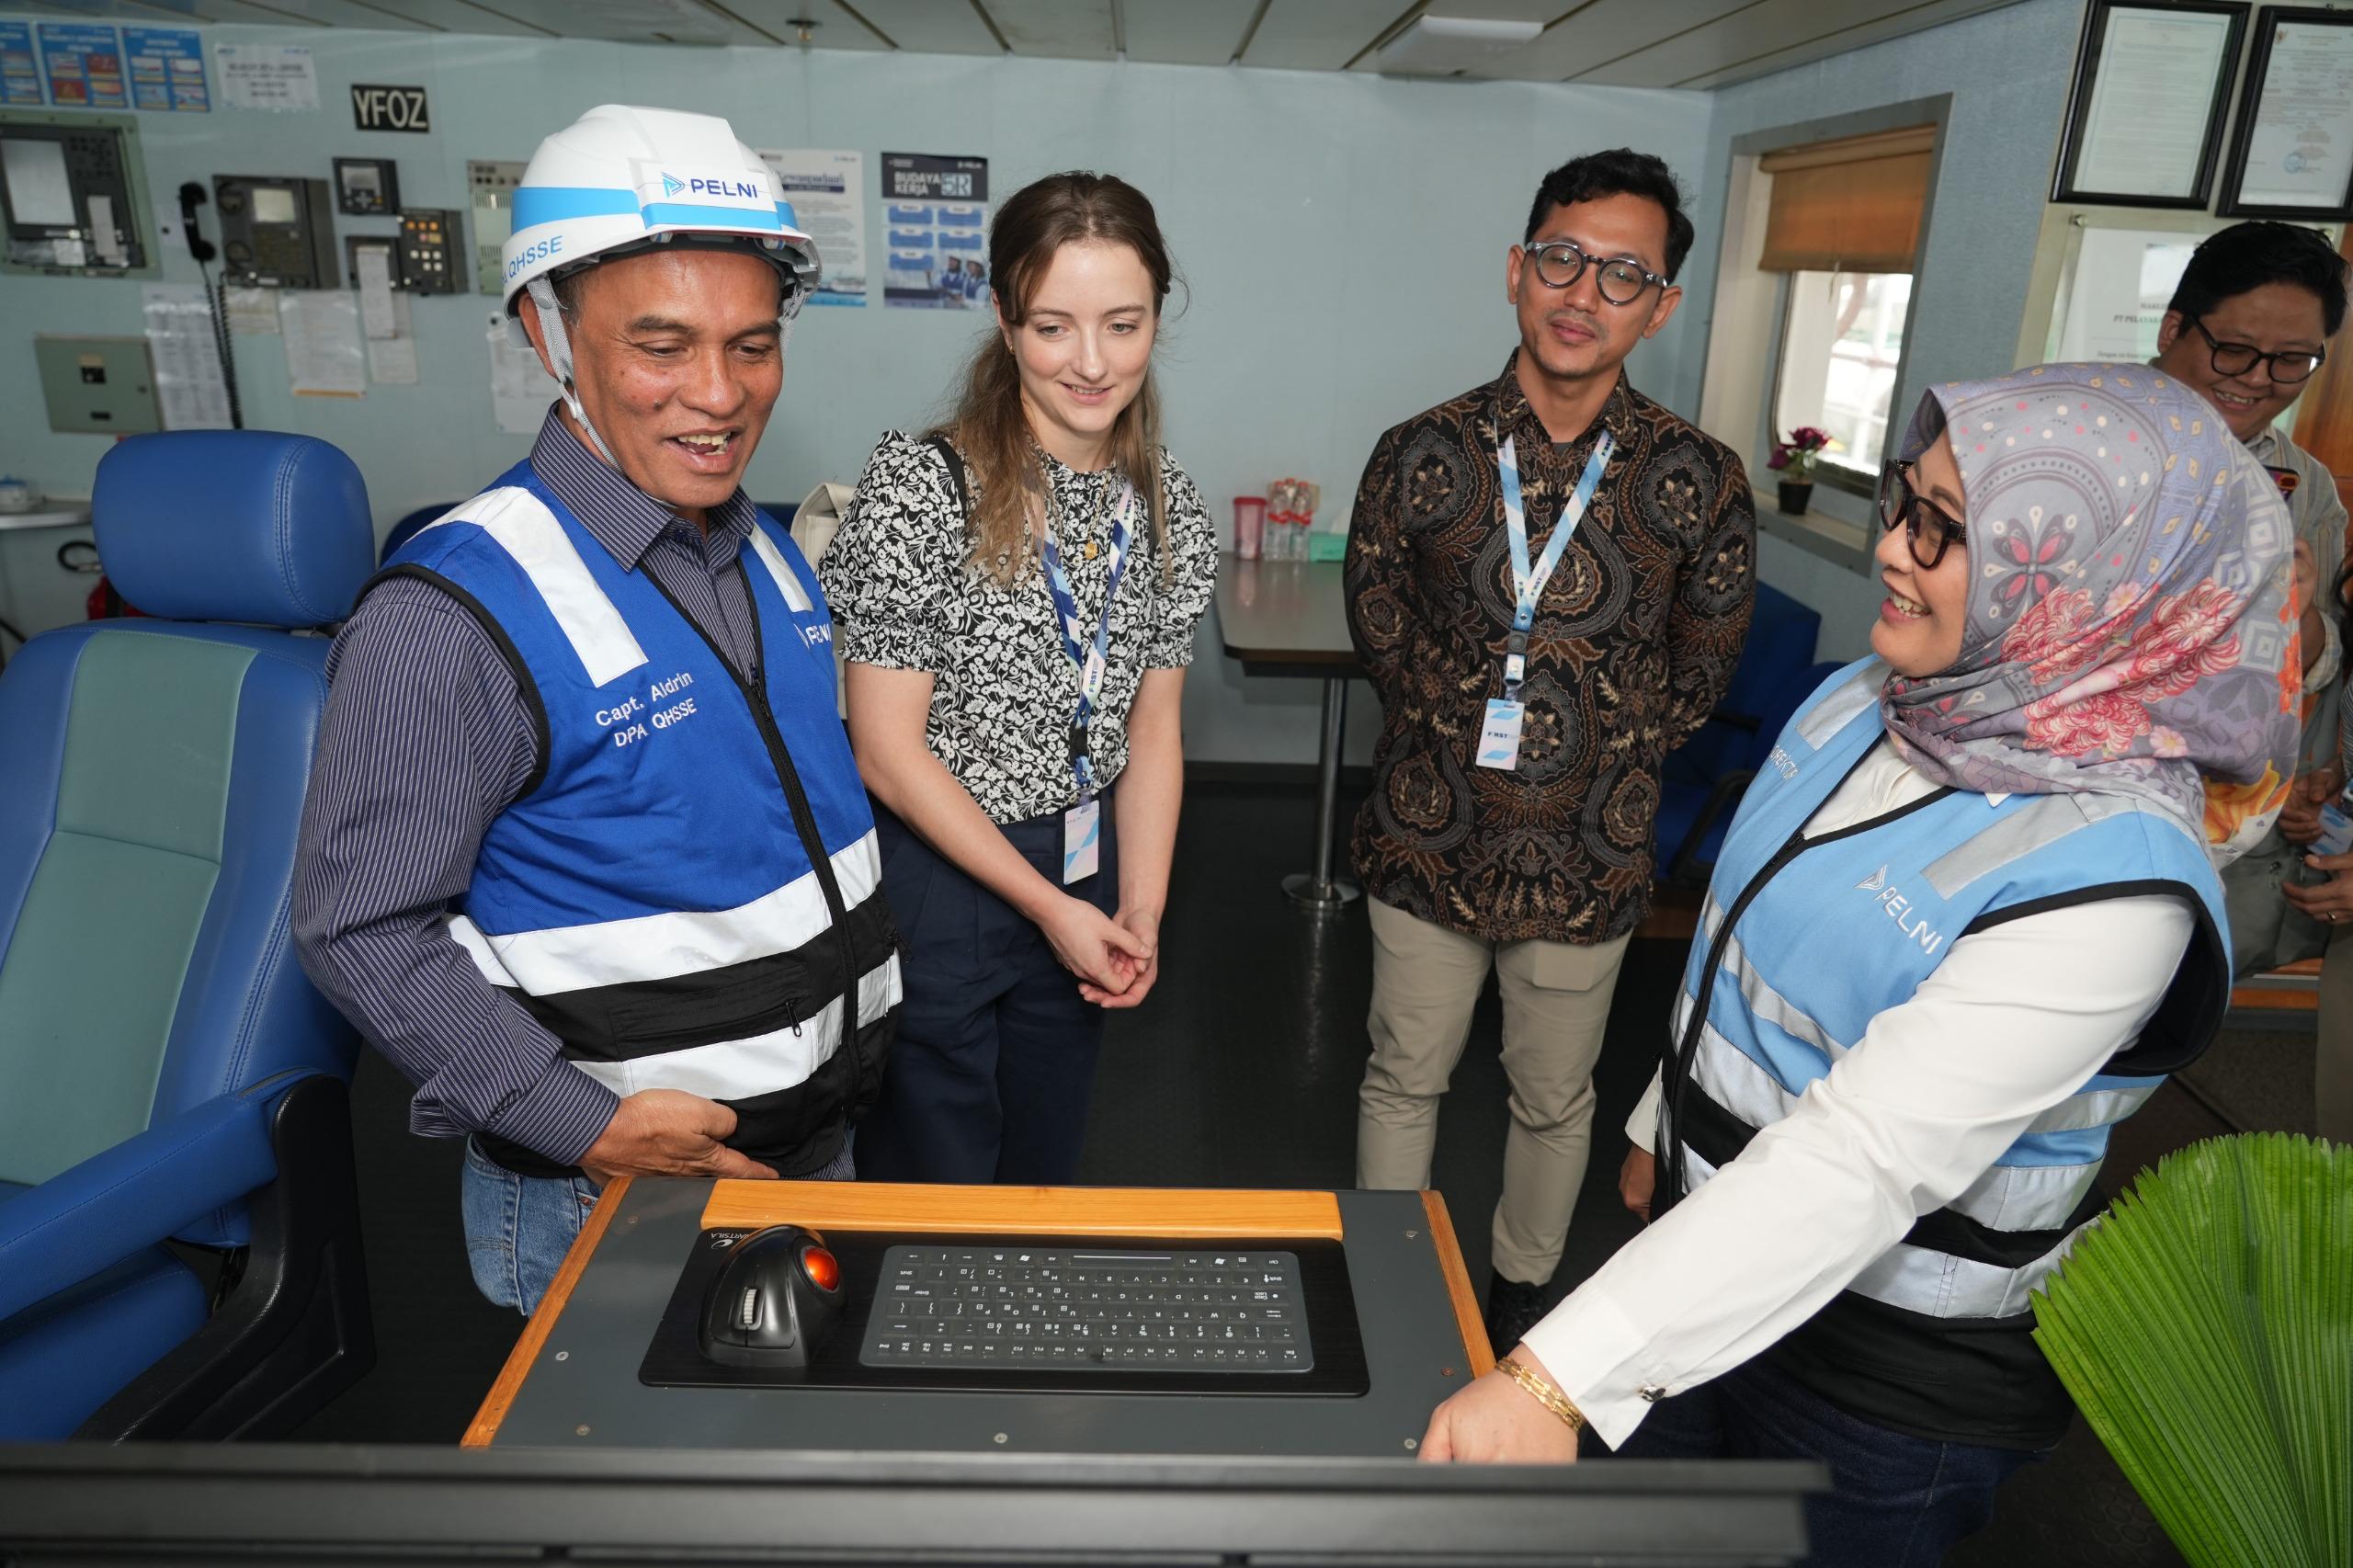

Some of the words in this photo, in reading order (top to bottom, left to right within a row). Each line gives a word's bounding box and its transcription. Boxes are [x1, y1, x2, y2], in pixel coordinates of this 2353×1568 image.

[353, 89, 427, 128] YFOZ
[690, 178, 758, 199] PELNI
[508, 235, 563, 278] QHSSE
[596, 696, 645, 726] Capt.
[651, 672, 694, 702] Aldrin
[614, 722, 650, 747] DPA
[652, 698, 698, 729] QHSSE
[1874, 885, 1944, 955] PELNI
